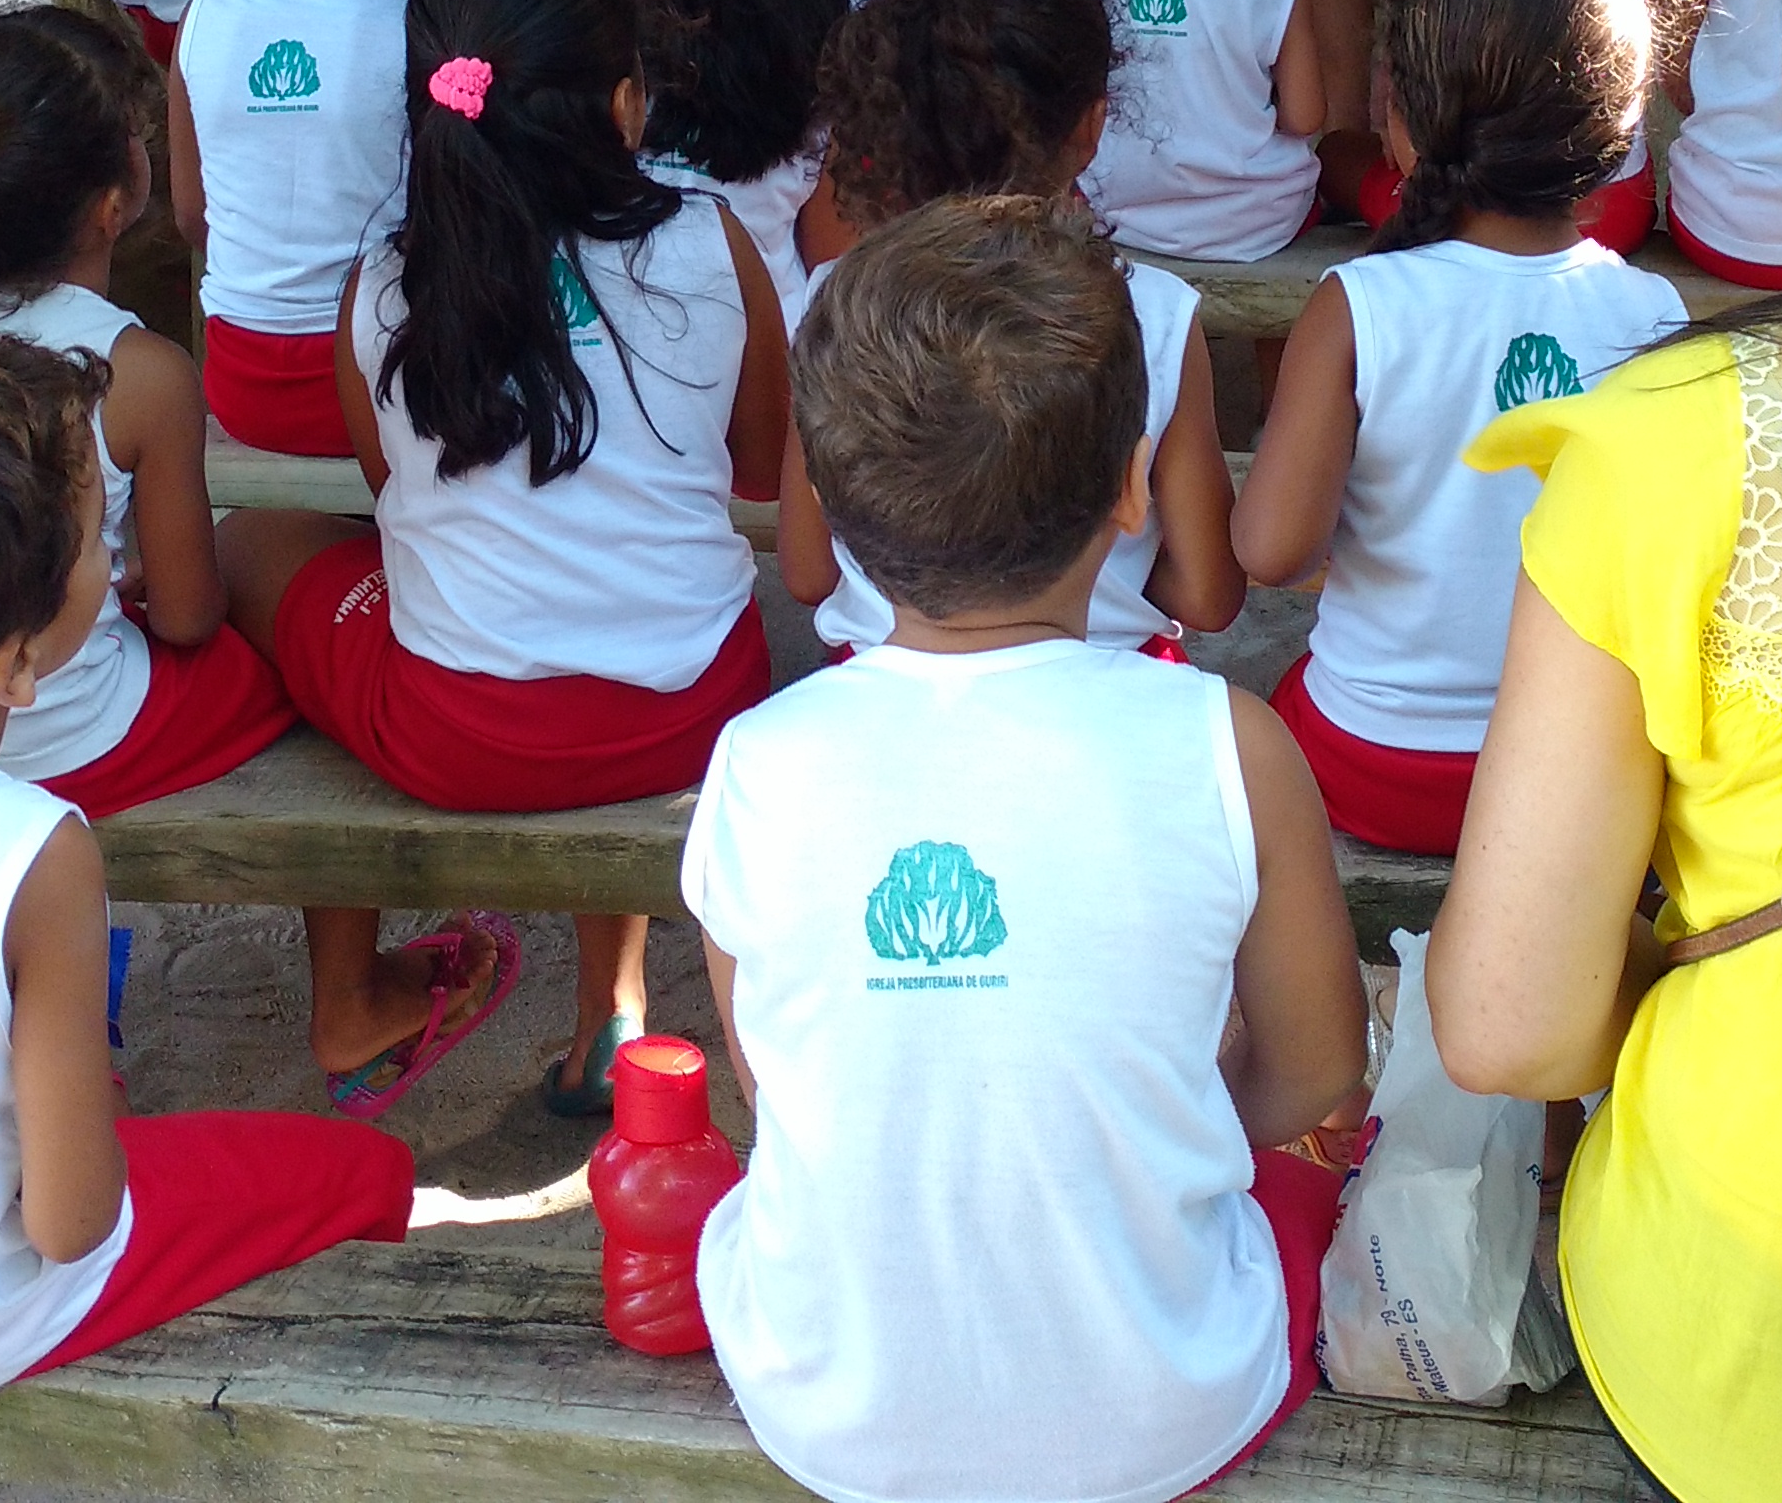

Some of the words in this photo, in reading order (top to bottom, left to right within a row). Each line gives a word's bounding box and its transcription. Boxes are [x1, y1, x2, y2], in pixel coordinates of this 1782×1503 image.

[866, 977, 896, 990] IGREJA
[897, 976, 964, 990] PRESBITERIANA
[966, 975, 978, 988] DE
[1370, 1234, 1388, 1293] Norte
[1397, 1298, 1418, 1325] ES
[1415, 1339, 1450, 1393] Mateus
